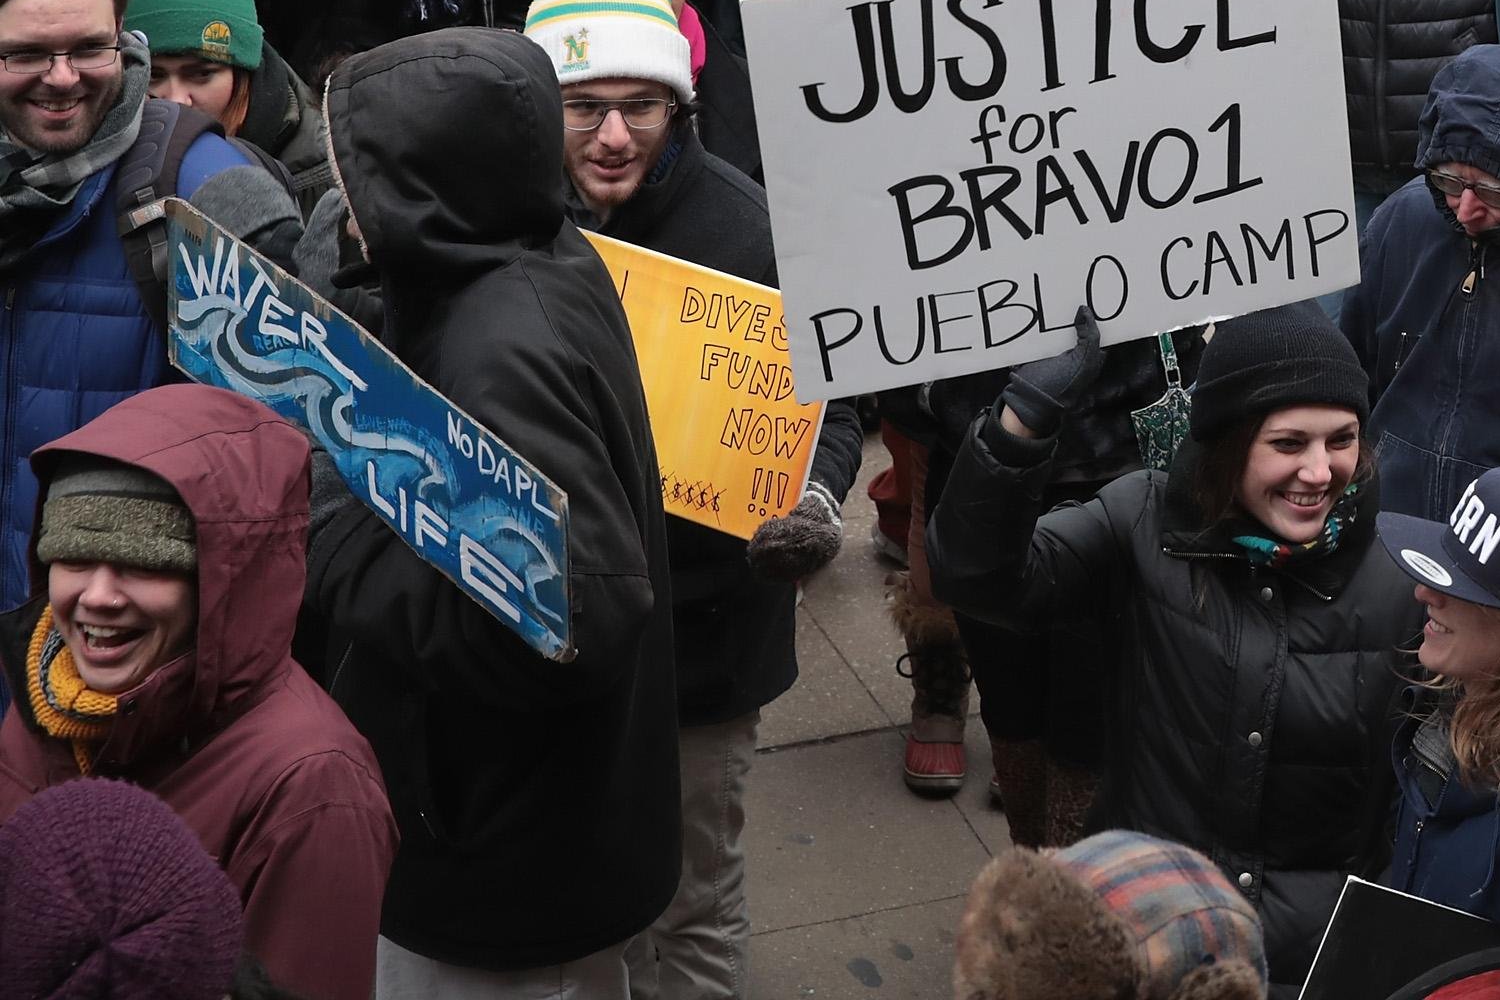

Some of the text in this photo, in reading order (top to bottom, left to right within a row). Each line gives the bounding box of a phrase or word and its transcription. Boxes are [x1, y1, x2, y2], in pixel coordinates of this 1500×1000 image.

[970, 104, 1077, 165] for
[177, 236, 369, 392] WATER
[809, 208, 1350, 383] PUEBLO CAMP
[720, 407, 811, 460] NOW
[366, 460, 526, 623] LIFE
